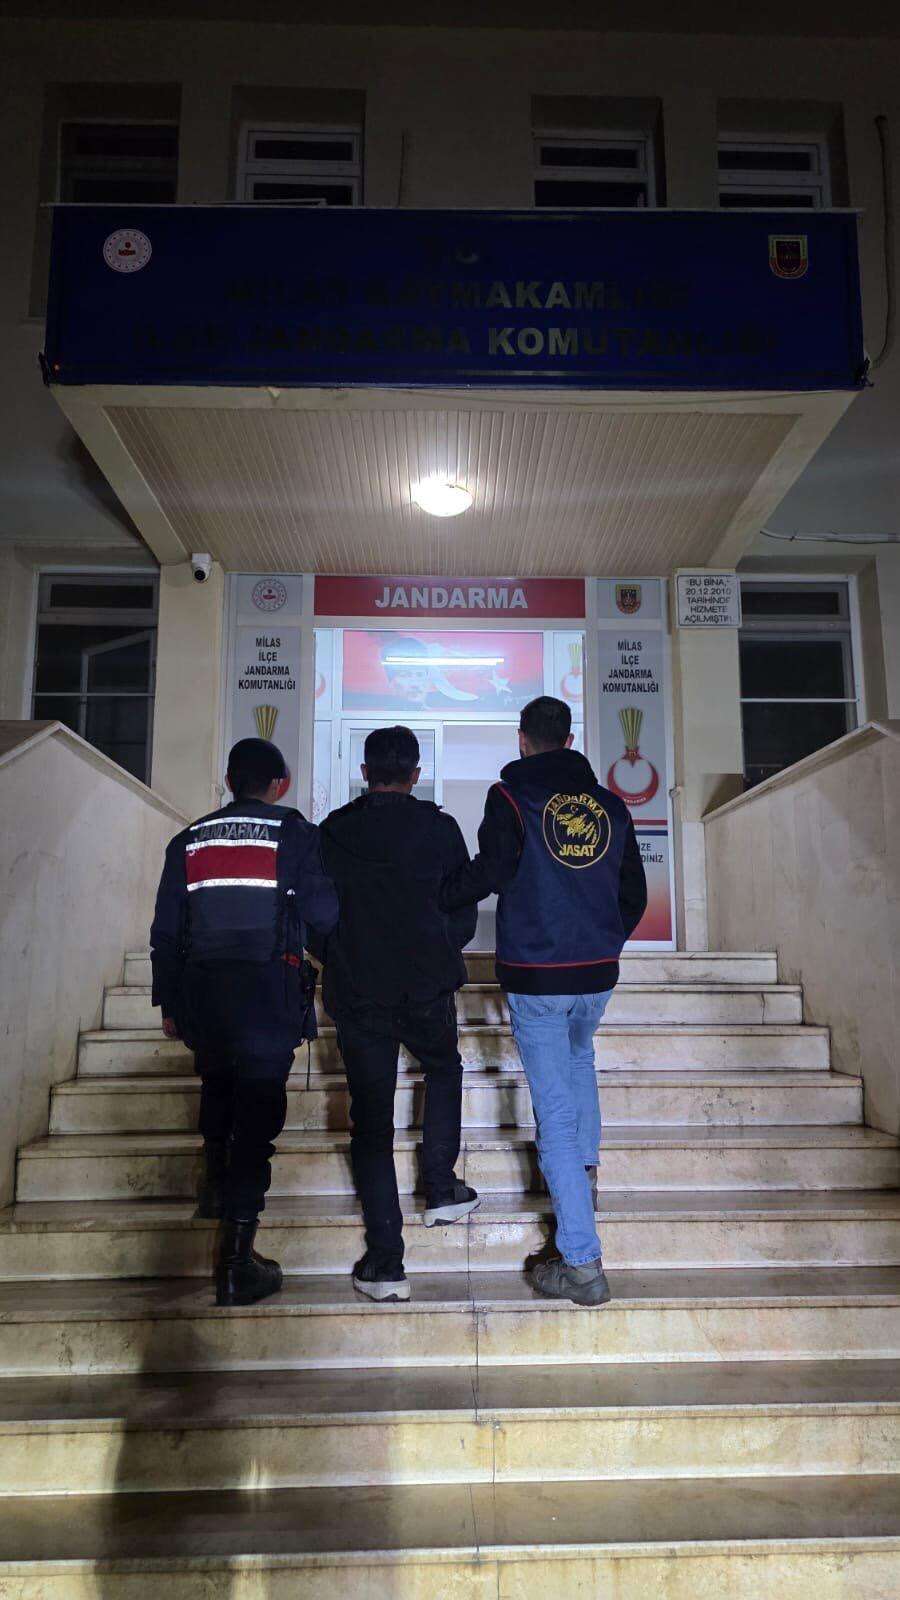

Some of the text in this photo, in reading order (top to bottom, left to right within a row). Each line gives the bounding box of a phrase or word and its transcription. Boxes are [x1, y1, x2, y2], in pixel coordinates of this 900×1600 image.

[689, 578, 702, 586] BU
[375, 586, 529, 609] JANDARMA
[255, 635, 281, 648] MİLAS
[617, 639, 642, 652] MİLAS
[258, 650, 278, 664] İLÇE
[621, 653, 640, 668] İLÇE
[244, 665, 290, 676] JANDARMA
[608, 668, 653, 680] JANDARMA
[238, 677, 296, 690] KOMUTANLIĞI
[602, 681, 659, 694] KOMUTANLIĞI
[559, 843, 595, 857] JASAT
